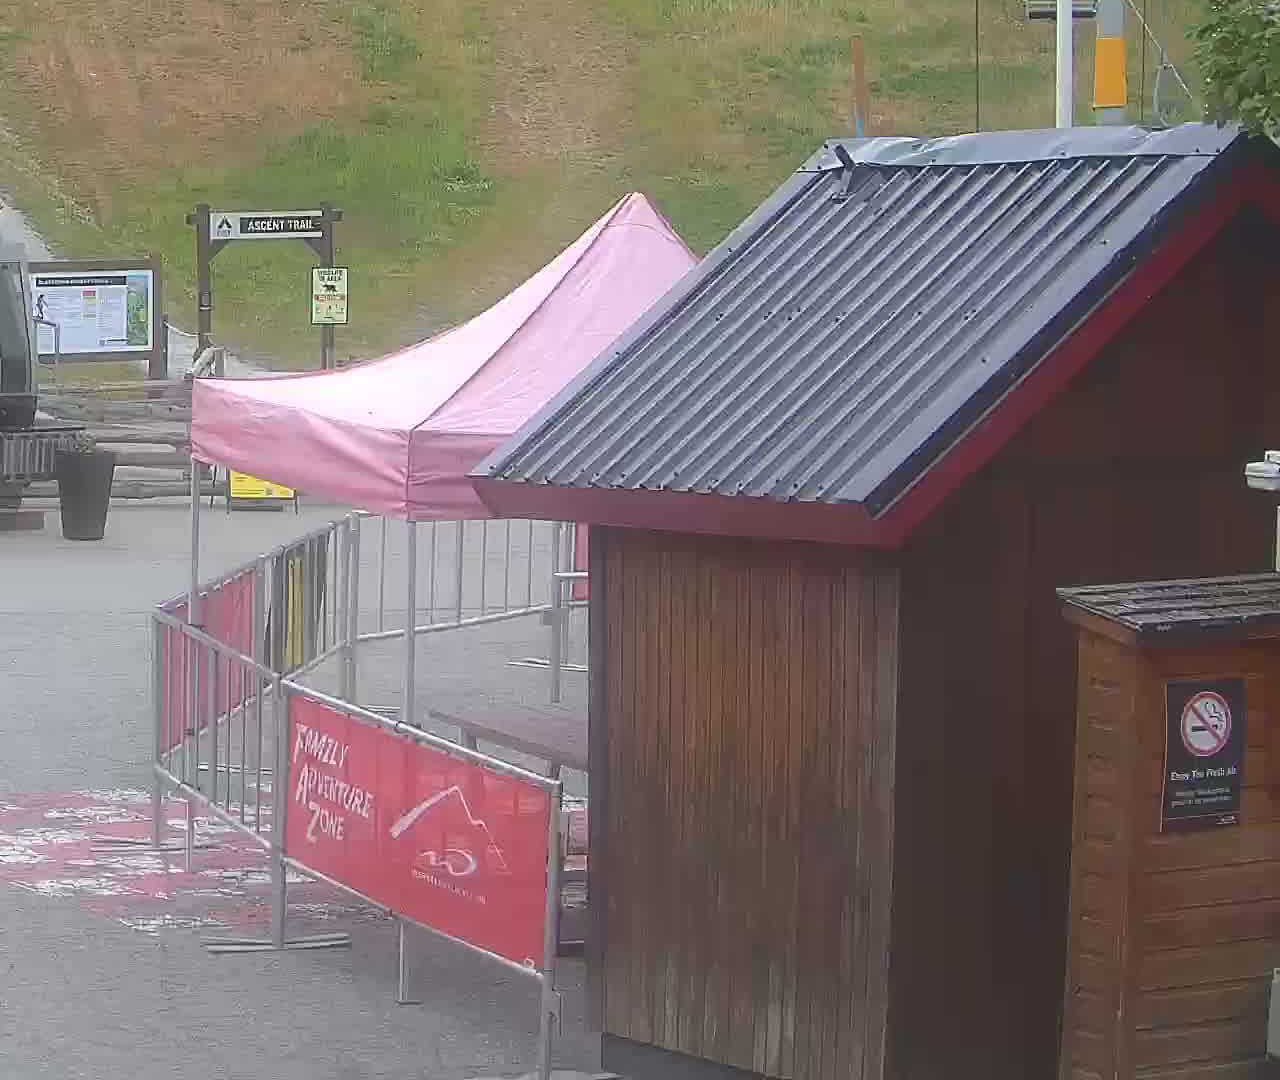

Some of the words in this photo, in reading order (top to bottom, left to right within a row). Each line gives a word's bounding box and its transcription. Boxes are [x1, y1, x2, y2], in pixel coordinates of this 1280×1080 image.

[247, 220, 285, 232] ASCENT
[288, 219, 313, 231] TRAIL
[293, 722, 349, 769] FAMILY
[295, 762, 375, 819] ADVENTURE
[307, 800, 345, 844] ZONE
